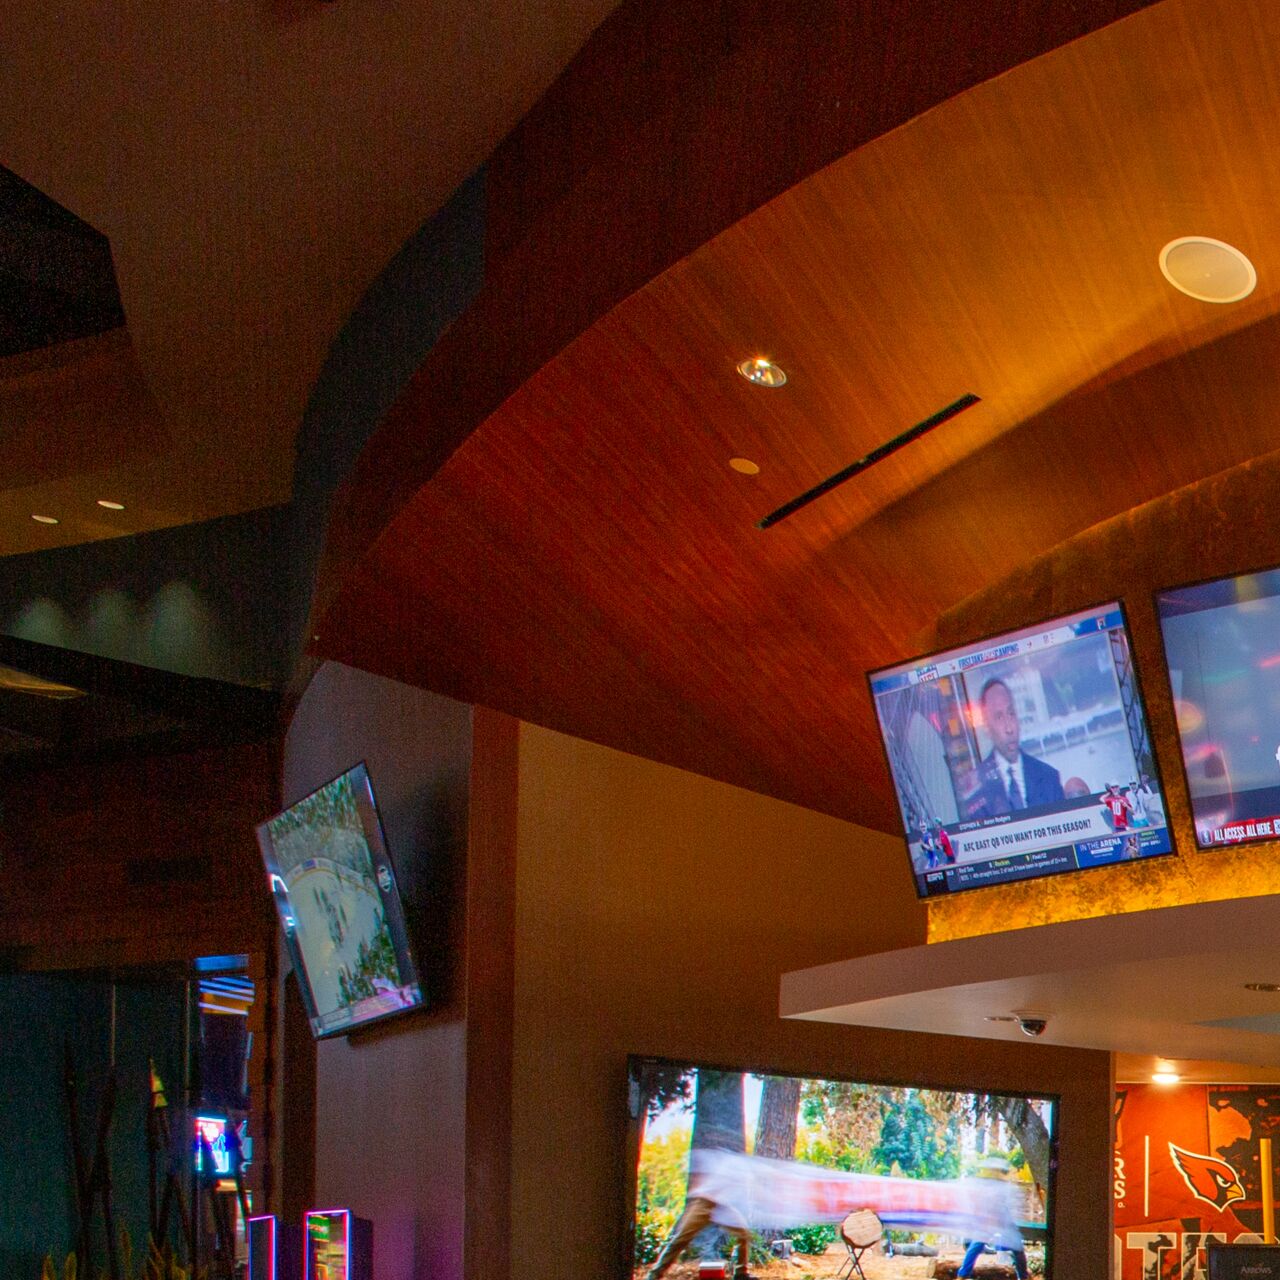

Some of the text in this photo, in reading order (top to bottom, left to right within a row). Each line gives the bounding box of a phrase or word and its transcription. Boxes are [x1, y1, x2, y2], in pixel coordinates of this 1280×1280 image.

[963, 819, 1091, 852] AFC EAST QB YOU WANT FOR THIS SEASON?
[1214, 829, 1225, 842] ALL
[1246, 825, 1257, 837] ALL
